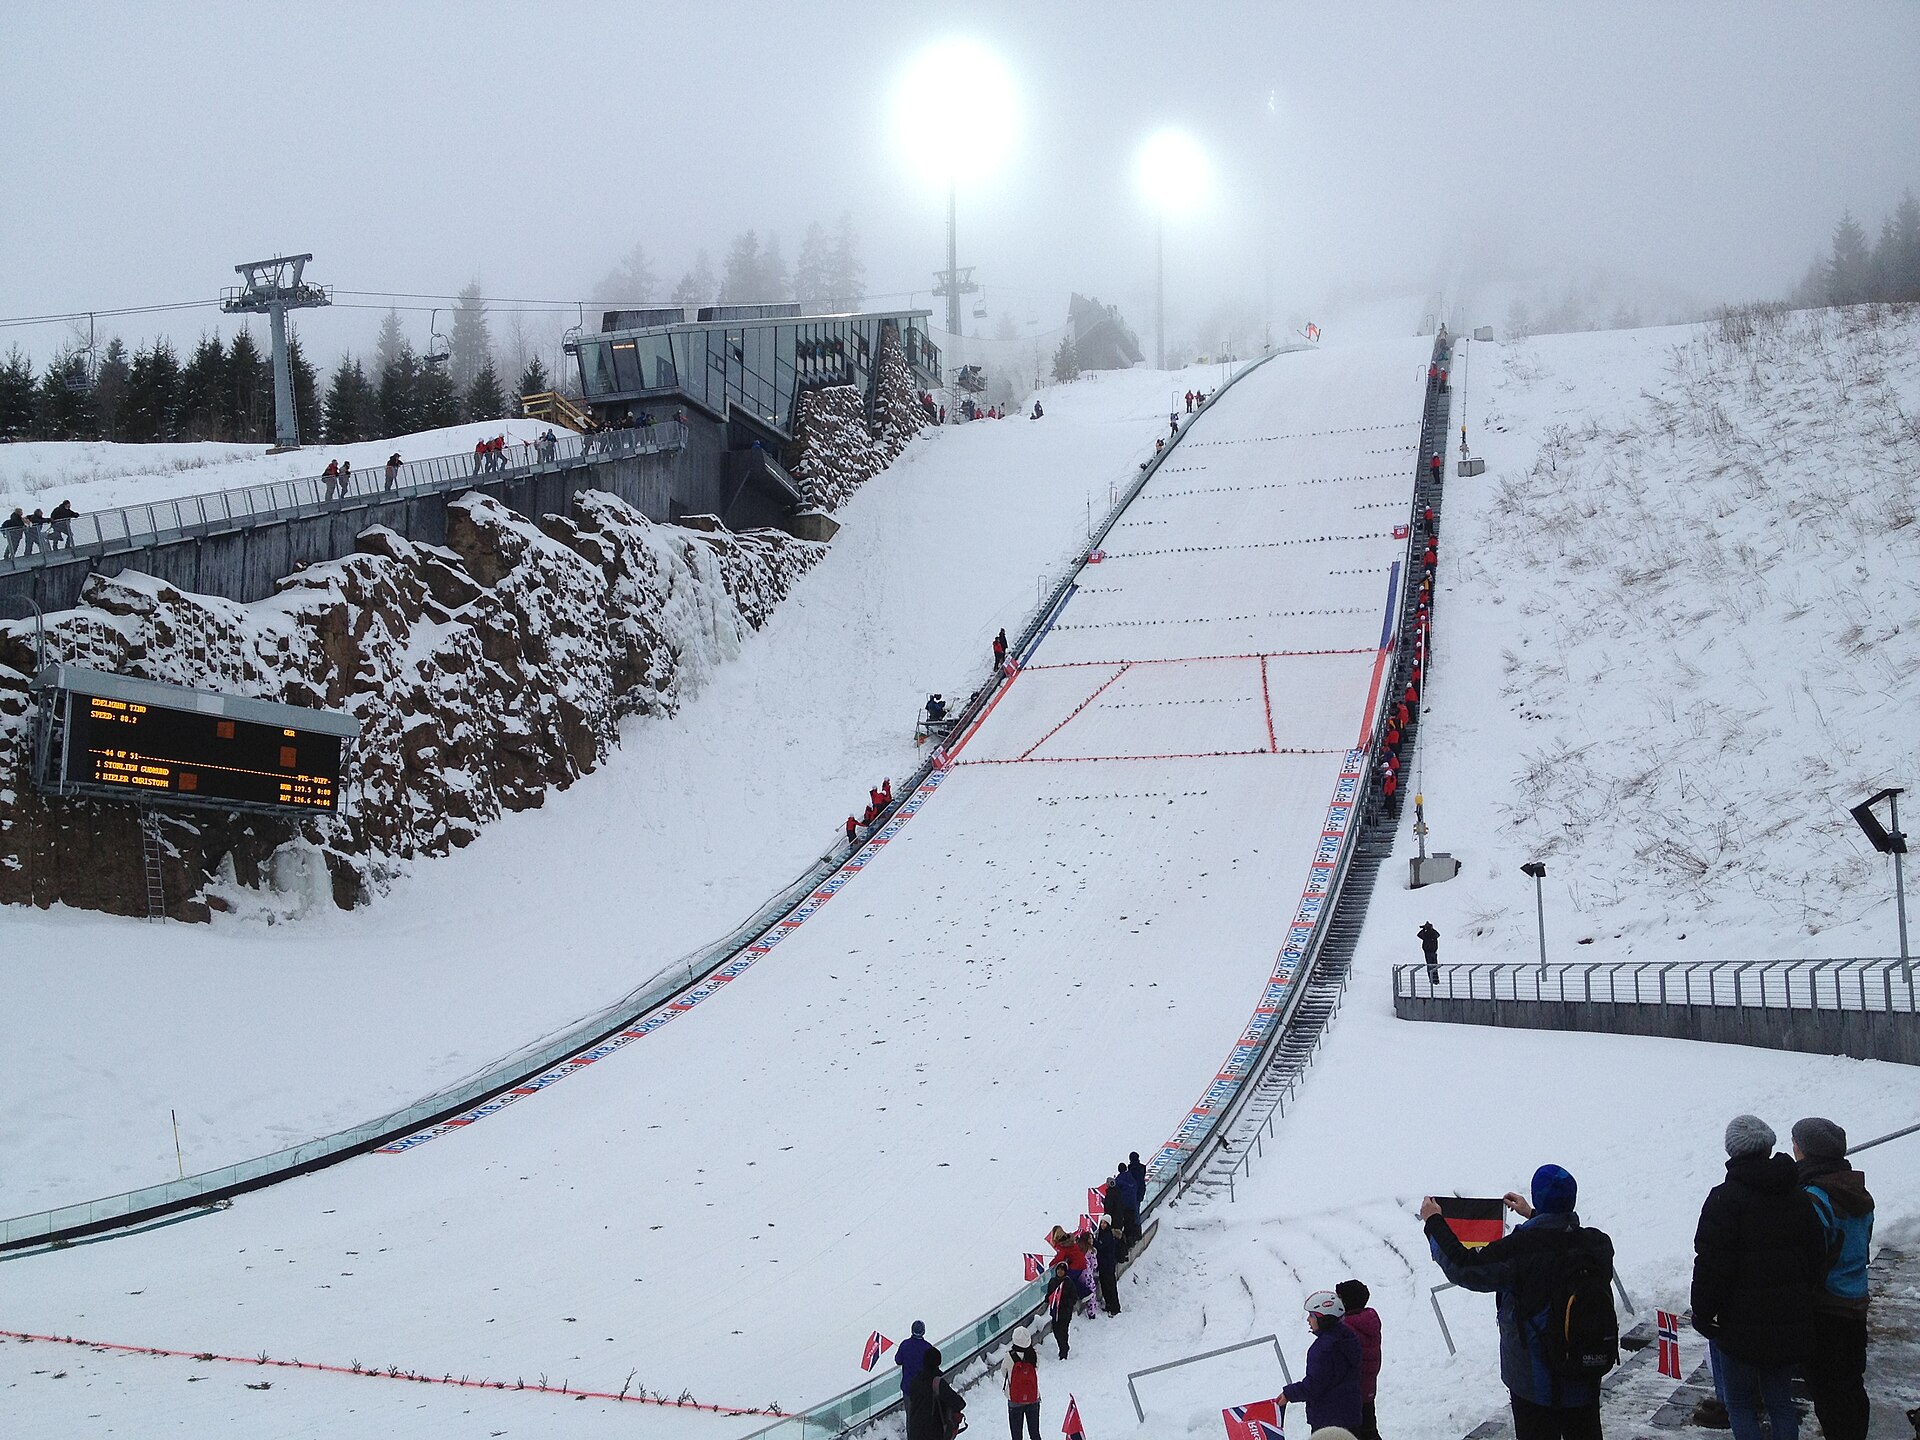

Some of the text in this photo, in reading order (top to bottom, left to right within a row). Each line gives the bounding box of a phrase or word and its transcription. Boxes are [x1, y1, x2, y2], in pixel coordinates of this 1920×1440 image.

[90, 711, 116, 720] SPEED:
[283, 729, 295, 737] GER
[117, 750, 126, 758] OF
[131, 776, 169, 787] CHRISTOPH
[1335, 778, 1355, 802] DKB.de
[903, 791, 931, 815] DKB.de
[878, 817, 908, 840] DKB.de
[1326, 807, 1348, 831] DKB.de
[851, 843, 882, 867] DKB.de
[1317, 837, 1339, 862] DKB.de
[821, 869, 856, 894] DKB.de
[1308, 868, 1330, 893] DKB.de
[789, 897, 826, 923] DKB.de
[1297, 898, 1321, 922] DKB.de
[757, 926, 794, 949] DKB.de
[720, 950, 763, 977] DKB.de
[1275, 952, 1301, 979] DKB.de
[678, 981, 725, 1006] DKB.de
[632, 1009, 683, 1034] DKB.de
[581, 1035, 633, 1061] DKB.de
[524, 1062, 582, 1091] DKB.de
[461, 1093, 521, 1122] DKB.de
[386, 1125, 455, 1151] DKB.de
